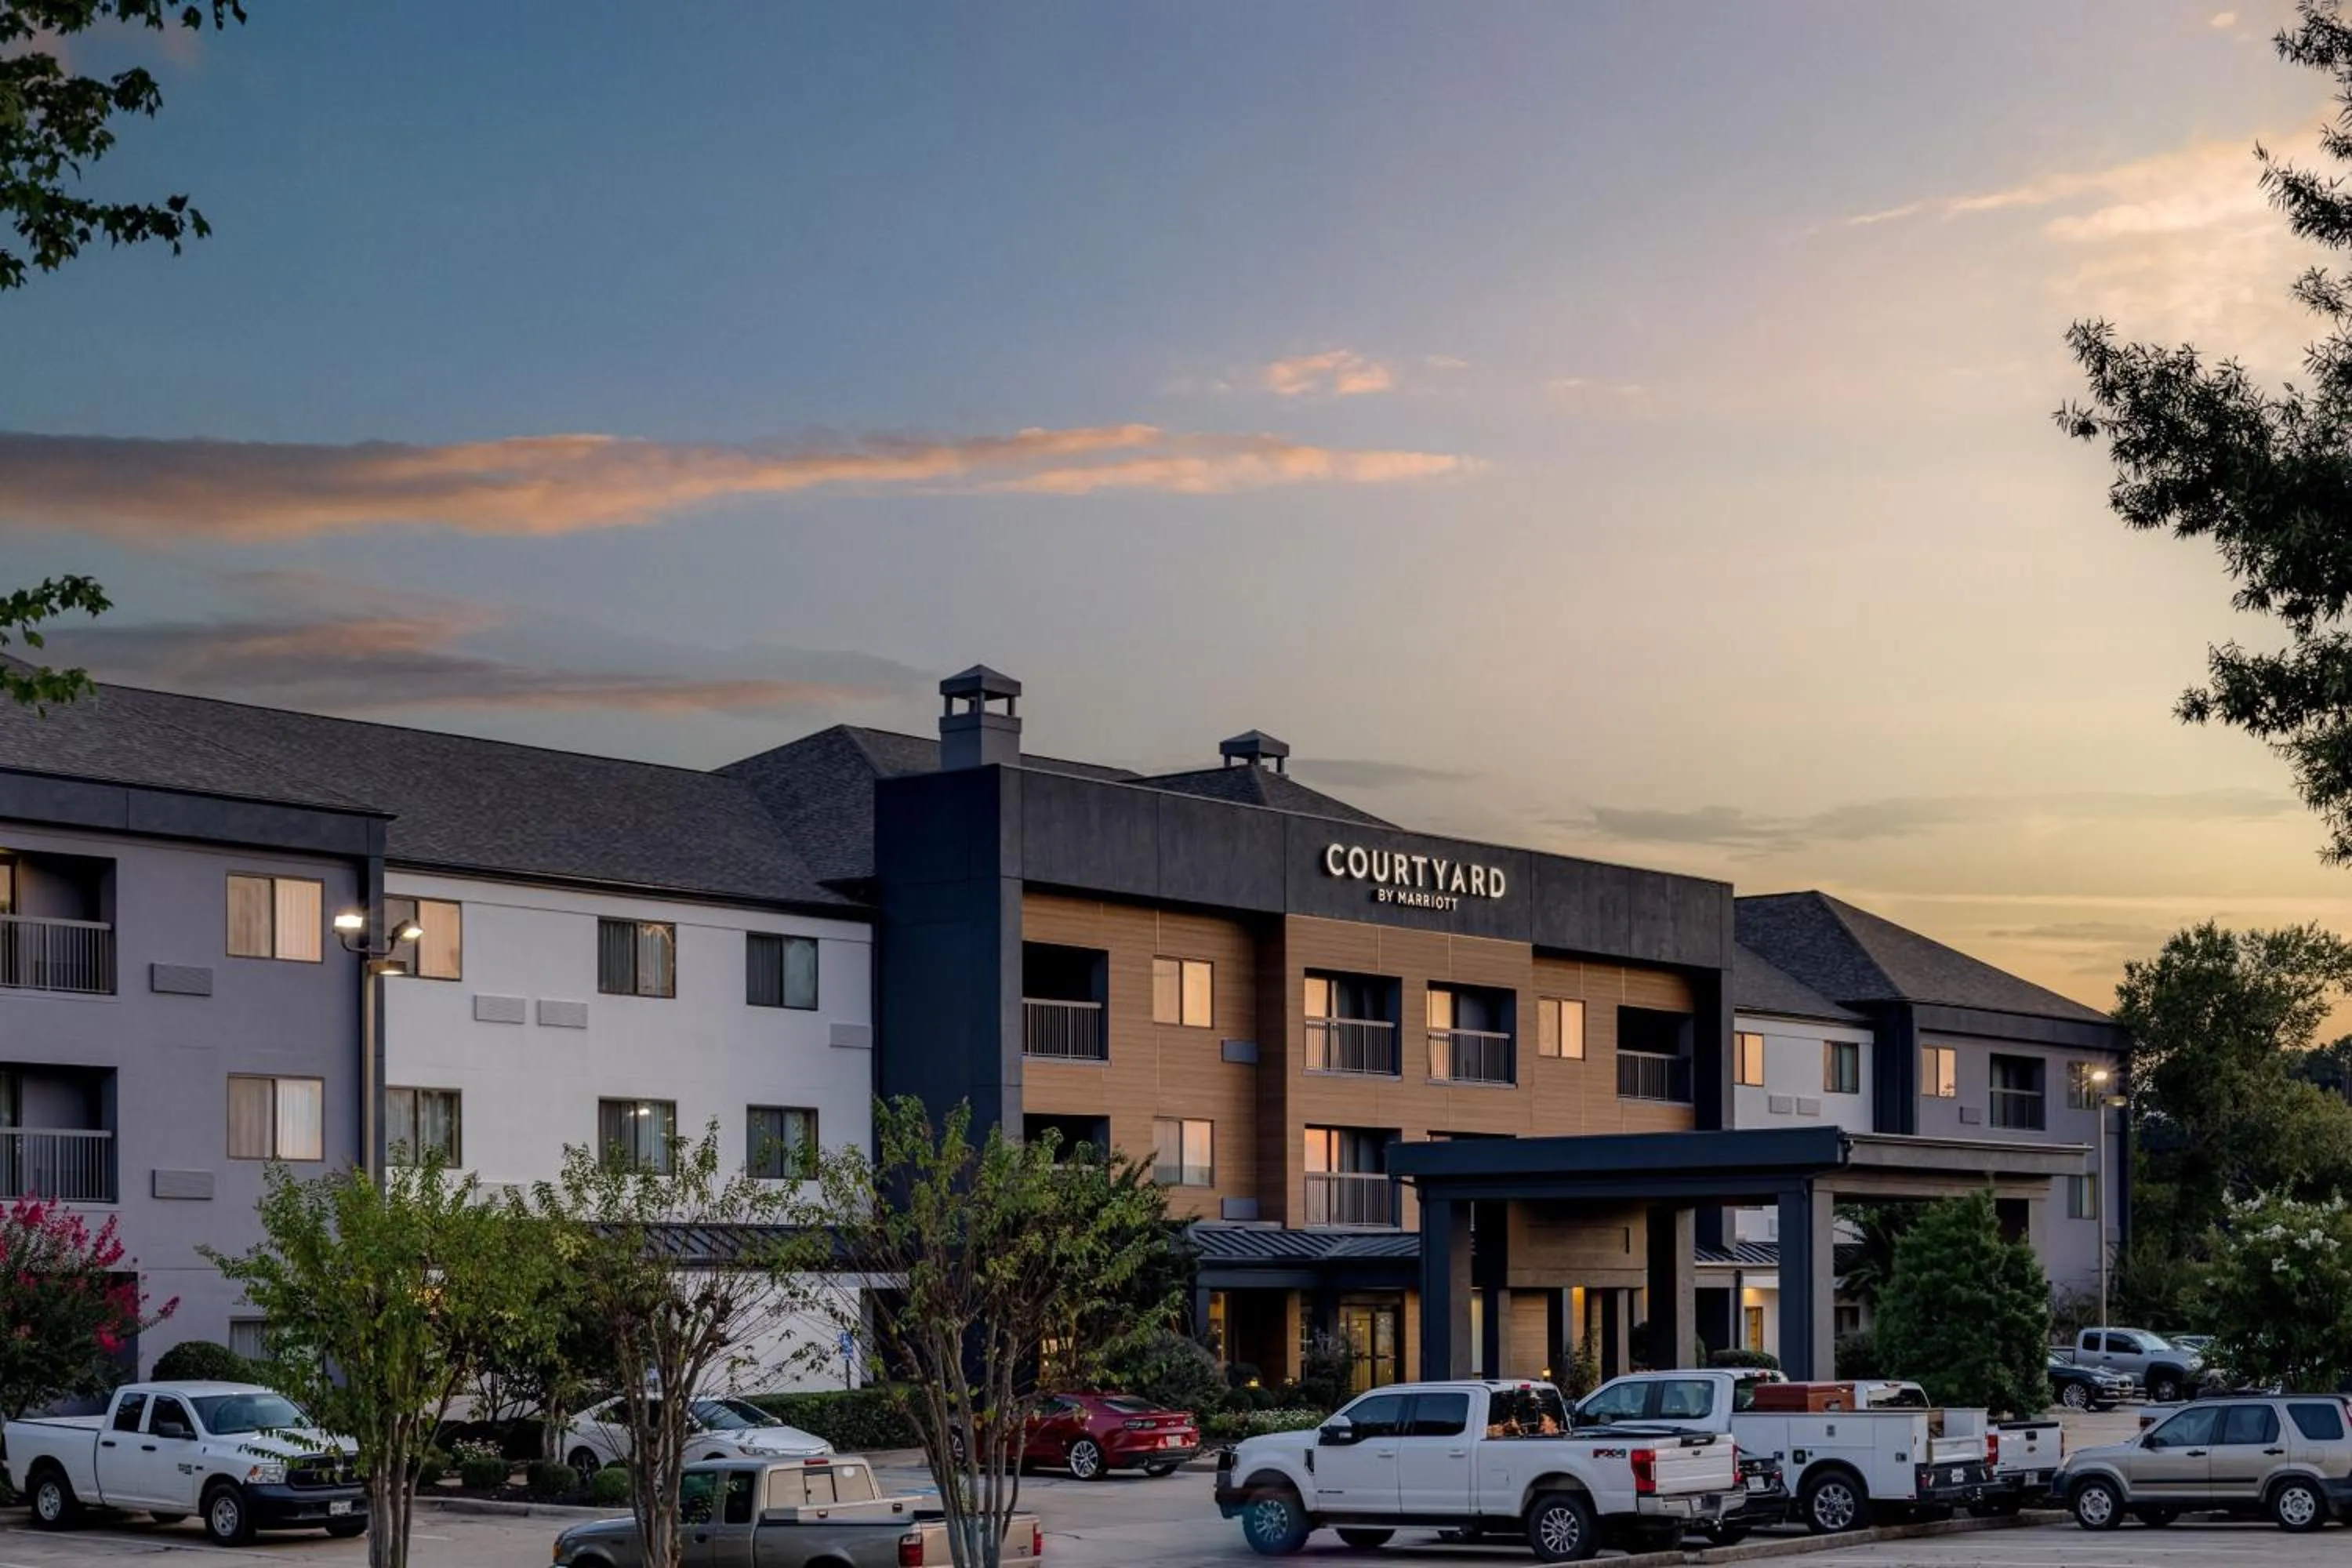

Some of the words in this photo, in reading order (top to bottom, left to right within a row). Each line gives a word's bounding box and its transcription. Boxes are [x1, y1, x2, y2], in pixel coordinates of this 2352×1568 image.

[1326, 843, 1506, 898] COURTYARD
[1377, 888, 1392, 902] BY
[1398, 891, 1458, 911] MARRIOTT
